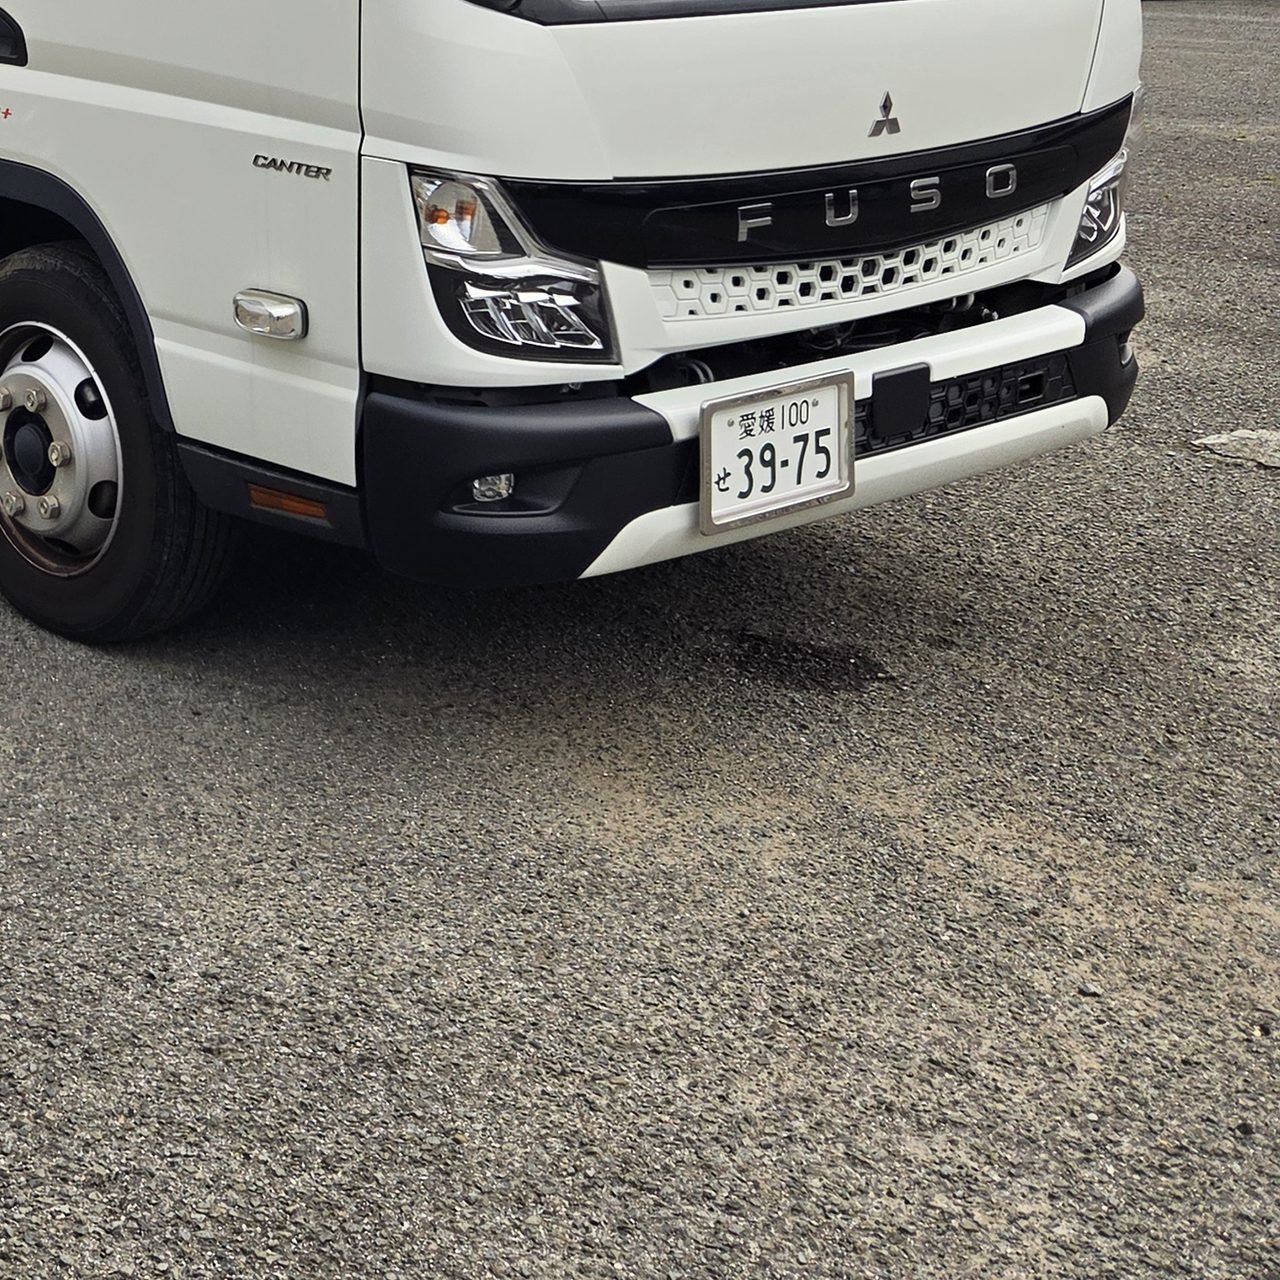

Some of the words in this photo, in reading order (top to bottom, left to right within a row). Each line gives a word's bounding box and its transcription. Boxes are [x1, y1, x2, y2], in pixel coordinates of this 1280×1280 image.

[252, 154, 333, 182] CANTER
[737, 163, 1018, 242] FUSO
[781, 399, 810, 430] 100
[713, 466, 732, 493] せ
[736, 427, 832, 500] 39-75
